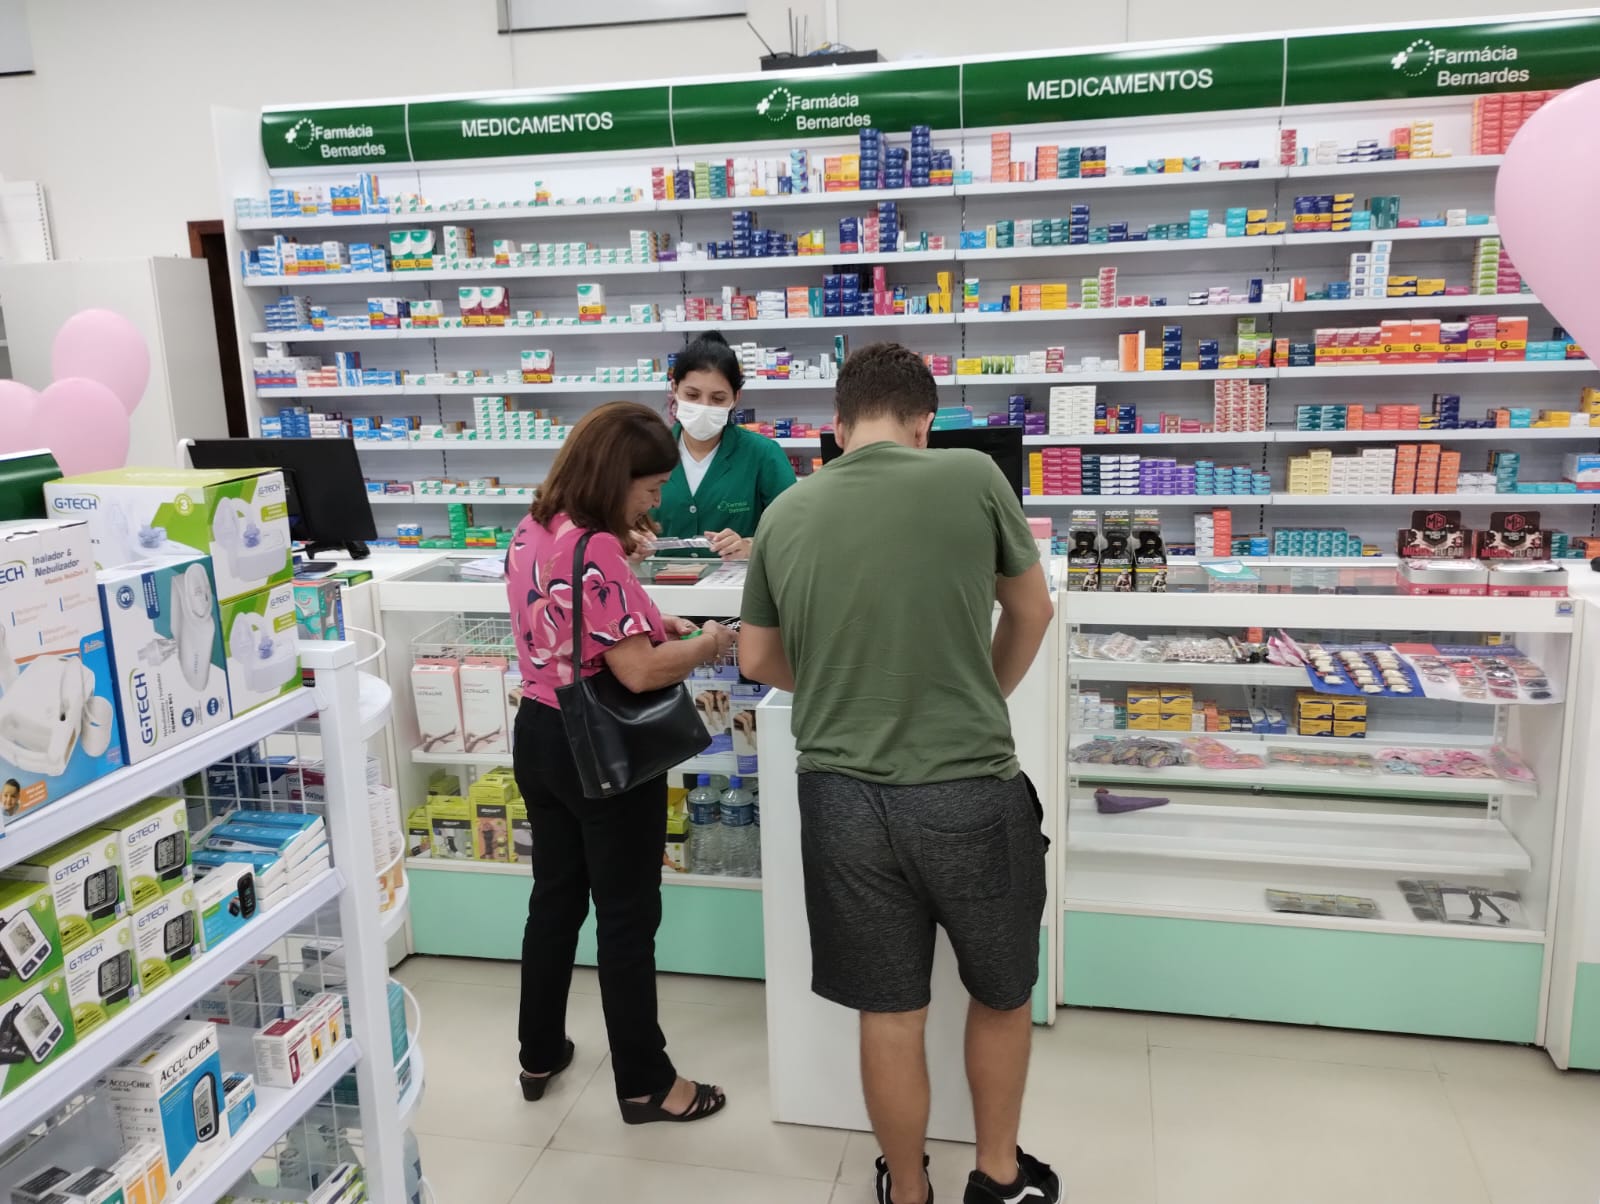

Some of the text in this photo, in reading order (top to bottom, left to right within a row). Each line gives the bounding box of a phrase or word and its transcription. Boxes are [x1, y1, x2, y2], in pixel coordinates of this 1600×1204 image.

[1434, 44, 1518, 65] Farmácia
[1027, 68, 1214, 101] MEDICAMENTOS
[1437, 67, 1530, 87] Bernardes
[791, 92, 859, 111] Farmácia
[461, 112, 614, 138] MEDICAMENTOS
[796, 113, 872, 131] Bernardes
[315, 124, 374, 140] Farmácia
[320, 142, 387, 158] Bernardes
[1384, 344, 1392, 353] G
[1414, 344, 1422, 352] G
[1500, 340, 1508, 349] G
[180, 498, 188, 510] 3
[32, 551, 64, 565] Inalador
[34, 560, 79, 577] Nebulizador
[160, 1037, 211, 1083] ACCU-CHEK
[109, 1078, 151, 1089] ACCU-CHEK
